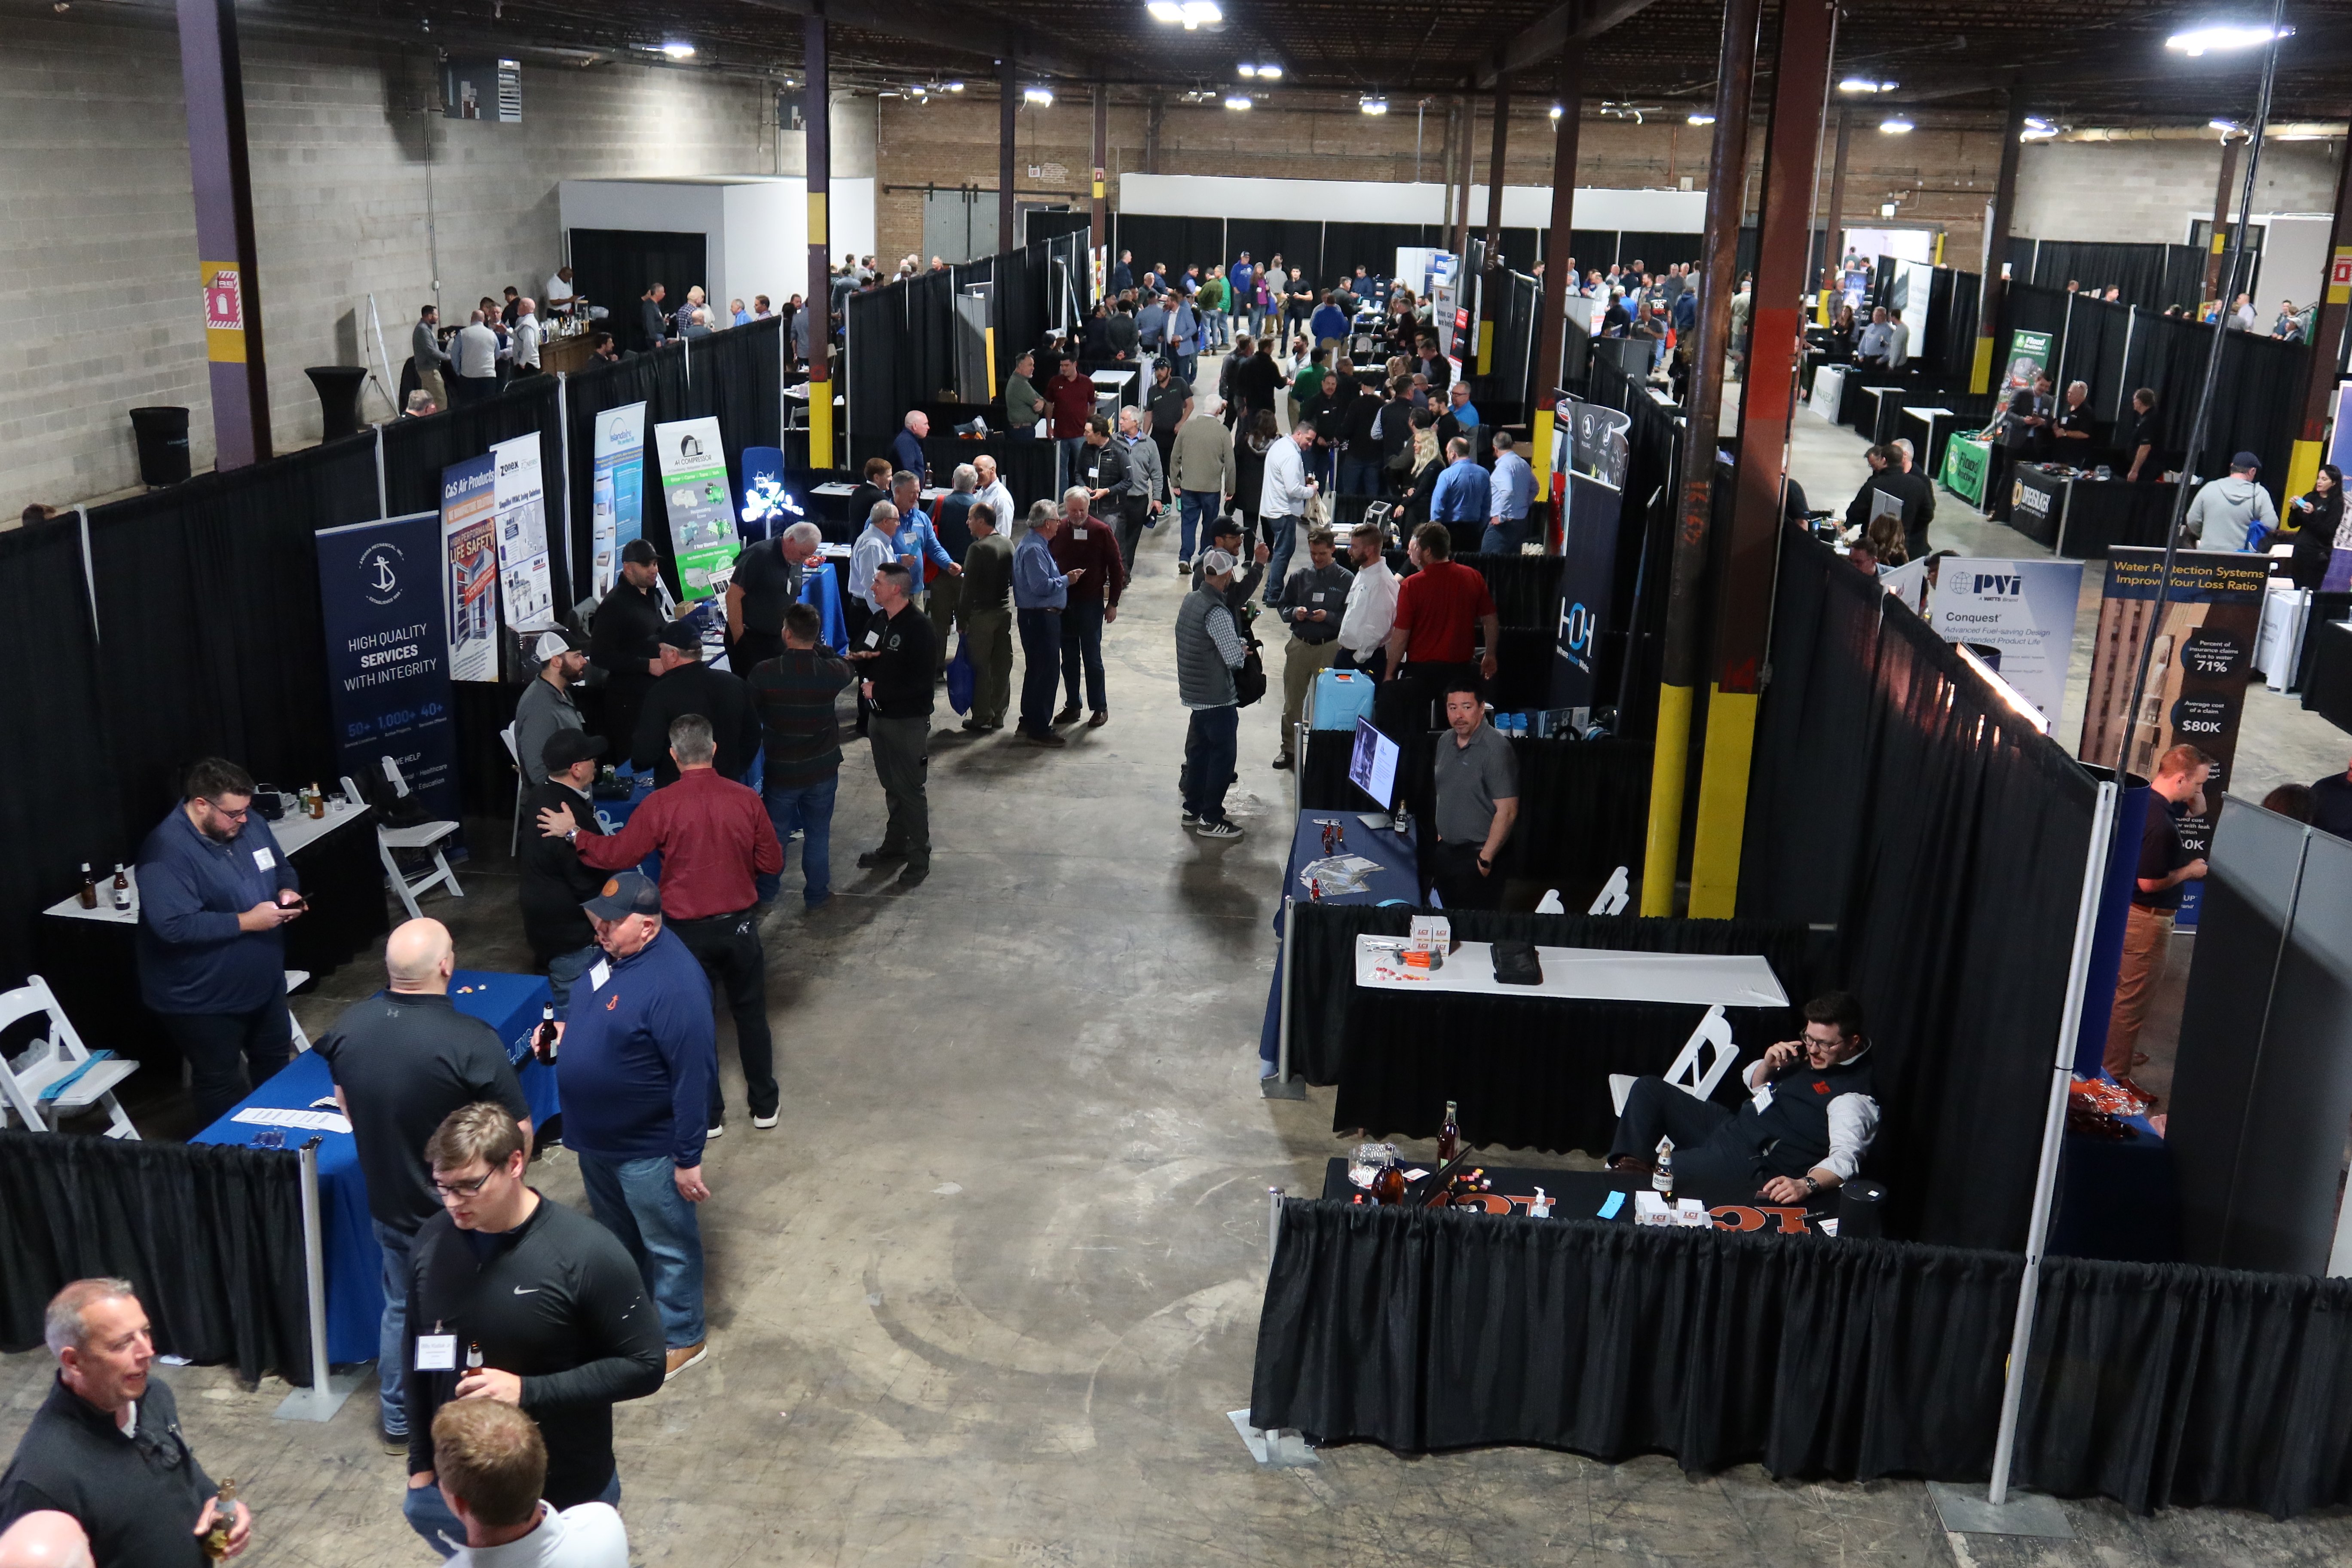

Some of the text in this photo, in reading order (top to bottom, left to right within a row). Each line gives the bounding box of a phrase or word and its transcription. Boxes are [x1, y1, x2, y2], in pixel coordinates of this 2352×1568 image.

[2026, 337, 2046, 346] Flood
[681, 455, 712, 465] COMPRESSOR
[459, 478, 468, 494] Air
[468, 469, 494, 490] Products
[450, 544, 466, 564] LIFE
[466, 532, 494, 556] SAFETY
[2114, 561, 2265, 579] Water Prtection Systems
[2116, 574, 2257, 591] Improv Your Loss Ratio
[1946, 612, 2000, 624] Conquest
[349, 623, 427, 652] HIGH QUALITY
[1944, 626, 2051, 637] Advanced Fuel-saving Design
[1944, 636, 2041, 646] With Extended Product Life
[361, 644, 419, 668] SERVICES
[1556, 644, 1568, 659] Where
[2196, 660, 2227, 673] 71%
[344, 672, 376, 692] WITH
[378, 658, 437, 684] INTEGRITY
[420, 703, 444, 717] 40+
[2184, 701, 2210, 709] Average
[378, 710, 416, 729] 1,000+
[2181, 719, 2222, 733] $80K
[348, 722, 371, 737] 50+
[404, 752, 421, 763] HELP
[420, 763, 447, 776] Healthcare
[419, 778, 445, 790] Education
[1651, 1214, 1667, 1223] LCI
[1682, 1211, 1699, 1220] LCI
